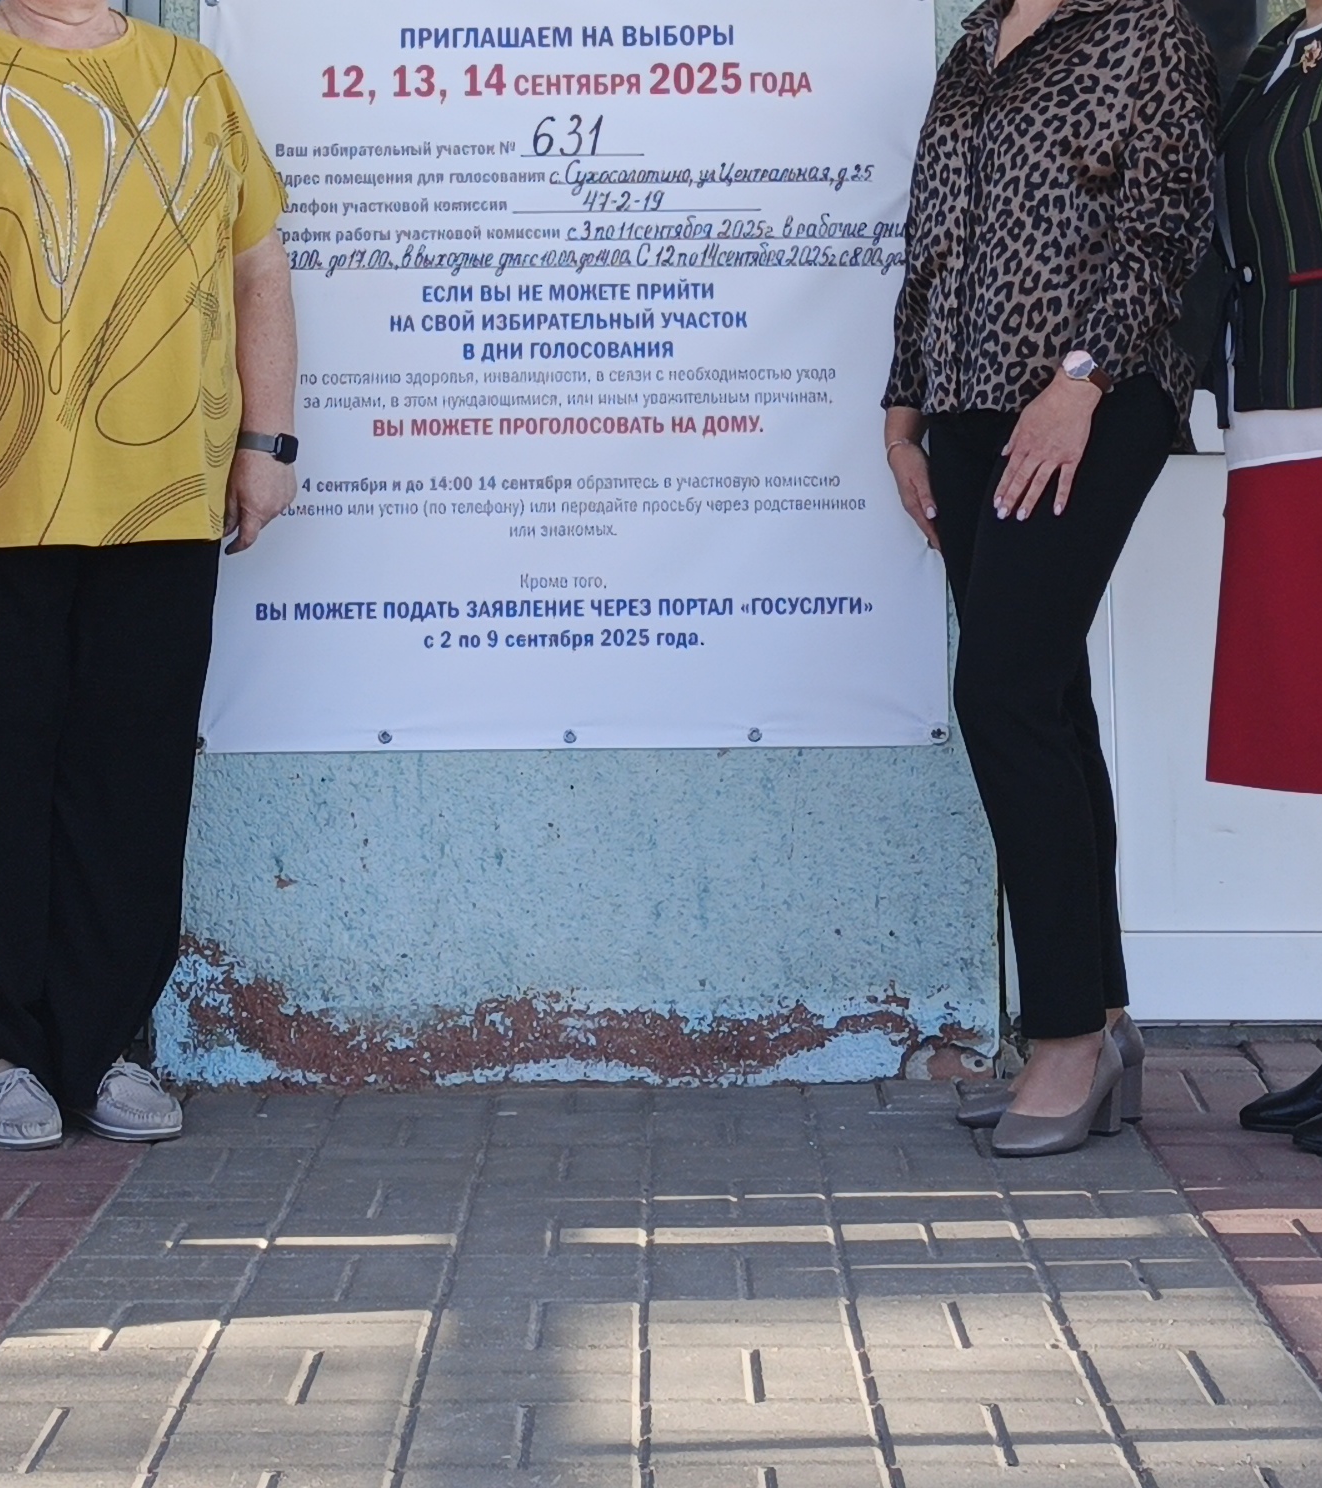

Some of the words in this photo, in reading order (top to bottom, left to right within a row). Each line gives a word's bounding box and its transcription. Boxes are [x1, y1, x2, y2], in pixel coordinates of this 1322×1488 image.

[401, 27, 572, 48] ПРИГЛАШАЕМ
[582, 26, 613, 47] НА
[623, 25, 733, 46] ВЫБОРЫ
[322, 65, 375, 105] 12,
[394, 65, 446, 104] 13,
[465, 64, 506, 96] 14
[514, 74, 640, 96] СЕНТЯБРЯ
[650, 62, 741, 94] 2025
[750, 72, 812, 97] ГОДА
[532, 114, 604, 156] 631
[276, 144, 307, 157] Ваш
[313, 142, 431, 158] избирательный
[437, 145, 495, 157] участок
[325, 173, 412, 186] помещения
[417, 173, 444, 186] для
[450, 172, 546, 184] голосования
[343, 198, 428, 215] участковой
[434, 201, 507, 211] комиссии
[336, 227, 391, 243] работы
[395, 226, 481, 243] участковой
[487, 229, 560, 240] комиссии
[423, 285, 472, 302] ЕСЛИ
[481, 285, 510, 301] ВЫ
[519, 285, 542, 301] НЕ
[549, 284, 630, 301] МОЖЕТЕ
[637, 279, 713, 300] ПРИЙТИ
[390, 315, 415, 332] НА
[422, 312, 474, 331] СВОЙ
[482, 310, 654, 331] ИЗБИРАТЕЛЬНЫЙ
[661, 311, 747, 328] УЧАСТОК
[463, 343, 475, 360] В
[481, 343, 522, 362] ДНИ
[531, 341, 673, 359] ГОЛОСОВАНИЯ
[373, 420, 403, 436] ВЫ
[411, 418, 493, 436] МОЖЕТЕ
[500, 416, 664, 435] ПРОГОЛОСОВАТЬ
[672, 416, 696, 433] НА
[702, 415, 763, 437] ДОМУ.
[317, 477, 387, 495] сентября
[430, 476, 472, 490] 14:00
[479, 476, 496, 490] 14
[502, 475, 571, 493] сентября
[577, 475, 659, 493] обратитесь
[677, 476, 760, 491] участковую
[765, 476, 840, 487] комиссию
[451, 500, 524, 516] телефону)
[562, 499, 637, 515] передайте
[643, 498, 702, 515] просьбу
[707, 500, 749, 513] через
[755, 499, 865, 513] родственников
[541, 525, 617, 537] знакомых.
[521, 573, 568, 592] Кроме
[574, 577, 606, 589] того,
[256, 602, 286, 620] ВЫ
[295, 602, 377, 620] МОЖЕТЕ
[384, 601, 459, 622] ПОДАТЬ
[467, 600, 584, 618] ЗАЯВЛЕНИЕ
[591, 599, 651, 617] ЧЕРЕЗ
[659, 598, 733, 616] ПОРТАЛ
[741, 597, 872, 615] «ГОСУСЛУГИ»
[424, 635, 433, 648] с
[441, 631, 451, 648] 2
[459, 635, 480, 648] по
[487, 630, 498, 648] 9
[505, 630, 593, 651] сентября
[601, 629, 649, 646] 2025
[657, 633, 704, 649] года.
